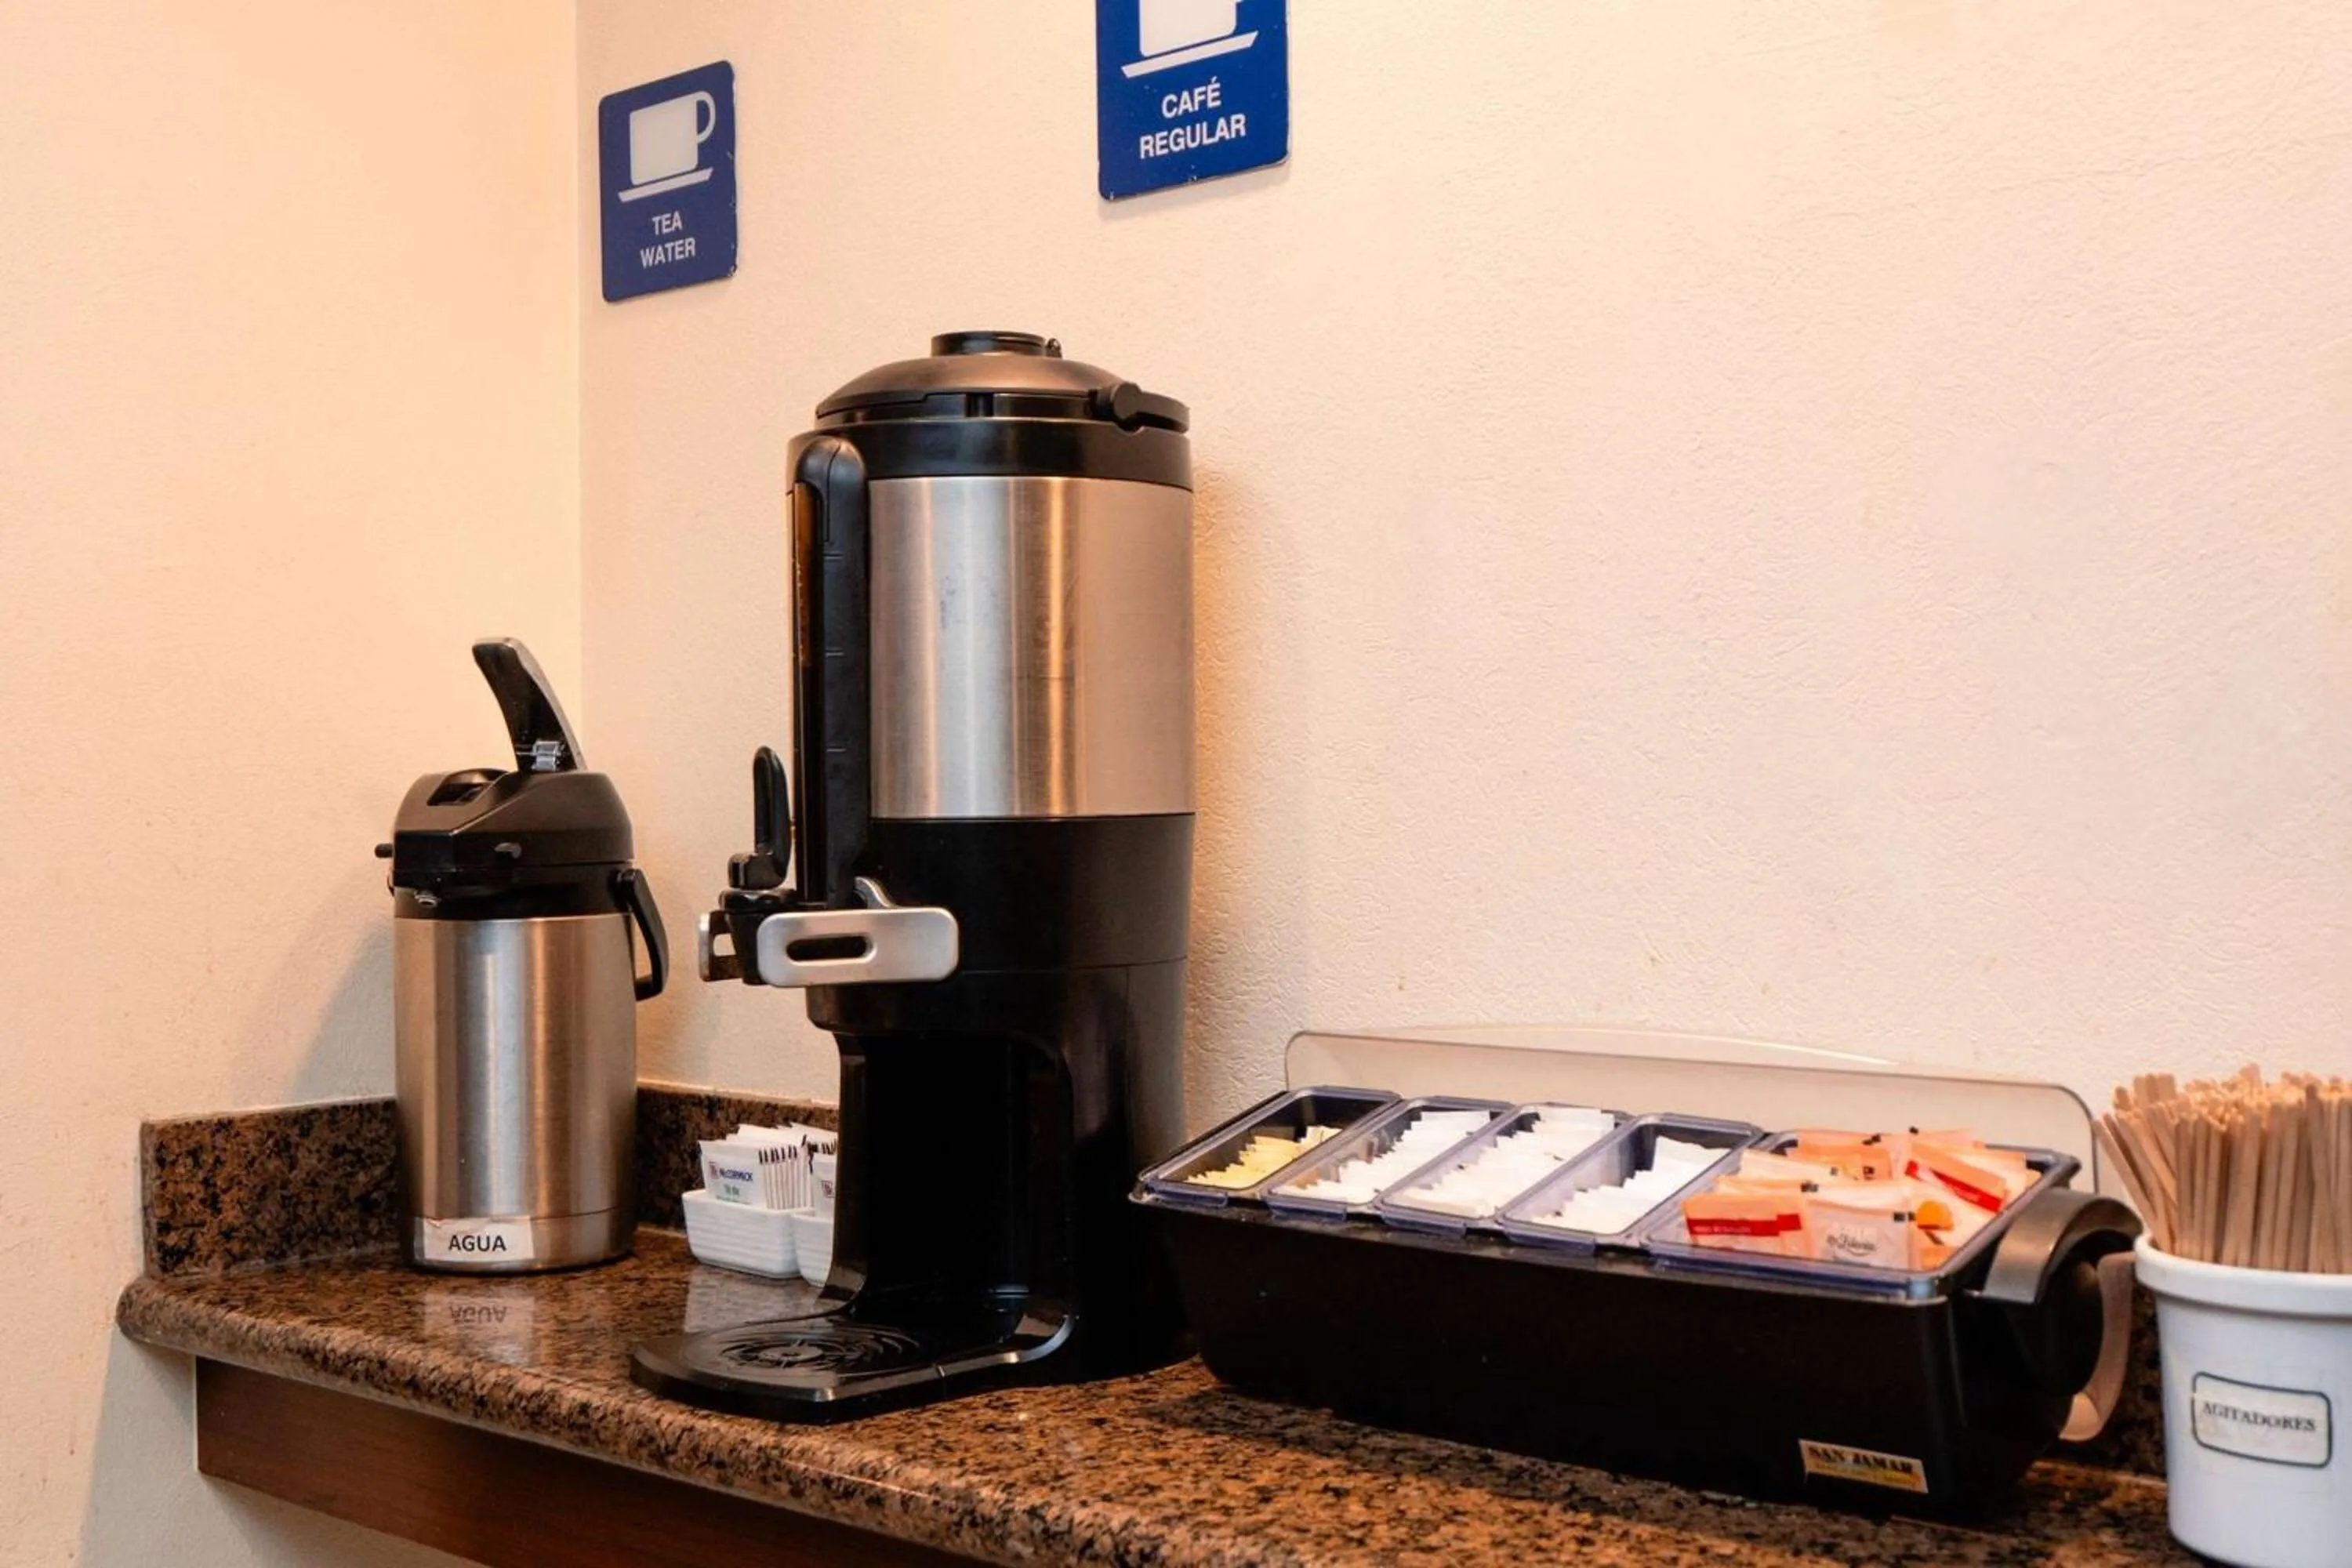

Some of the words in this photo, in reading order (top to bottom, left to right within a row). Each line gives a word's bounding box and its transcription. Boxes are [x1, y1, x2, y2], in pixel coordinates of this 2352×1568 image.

[1161, 76, 1221, 119] CAFÉ
[1140, 113, 1247, 159] REGULAR
[652, 210, 683, 235] TEA
[640, 238, 695, 269] WATER
[448, 1235, 506, 1252] AGUA
[2202, 1401, 2316, 1432] AGITADORES
